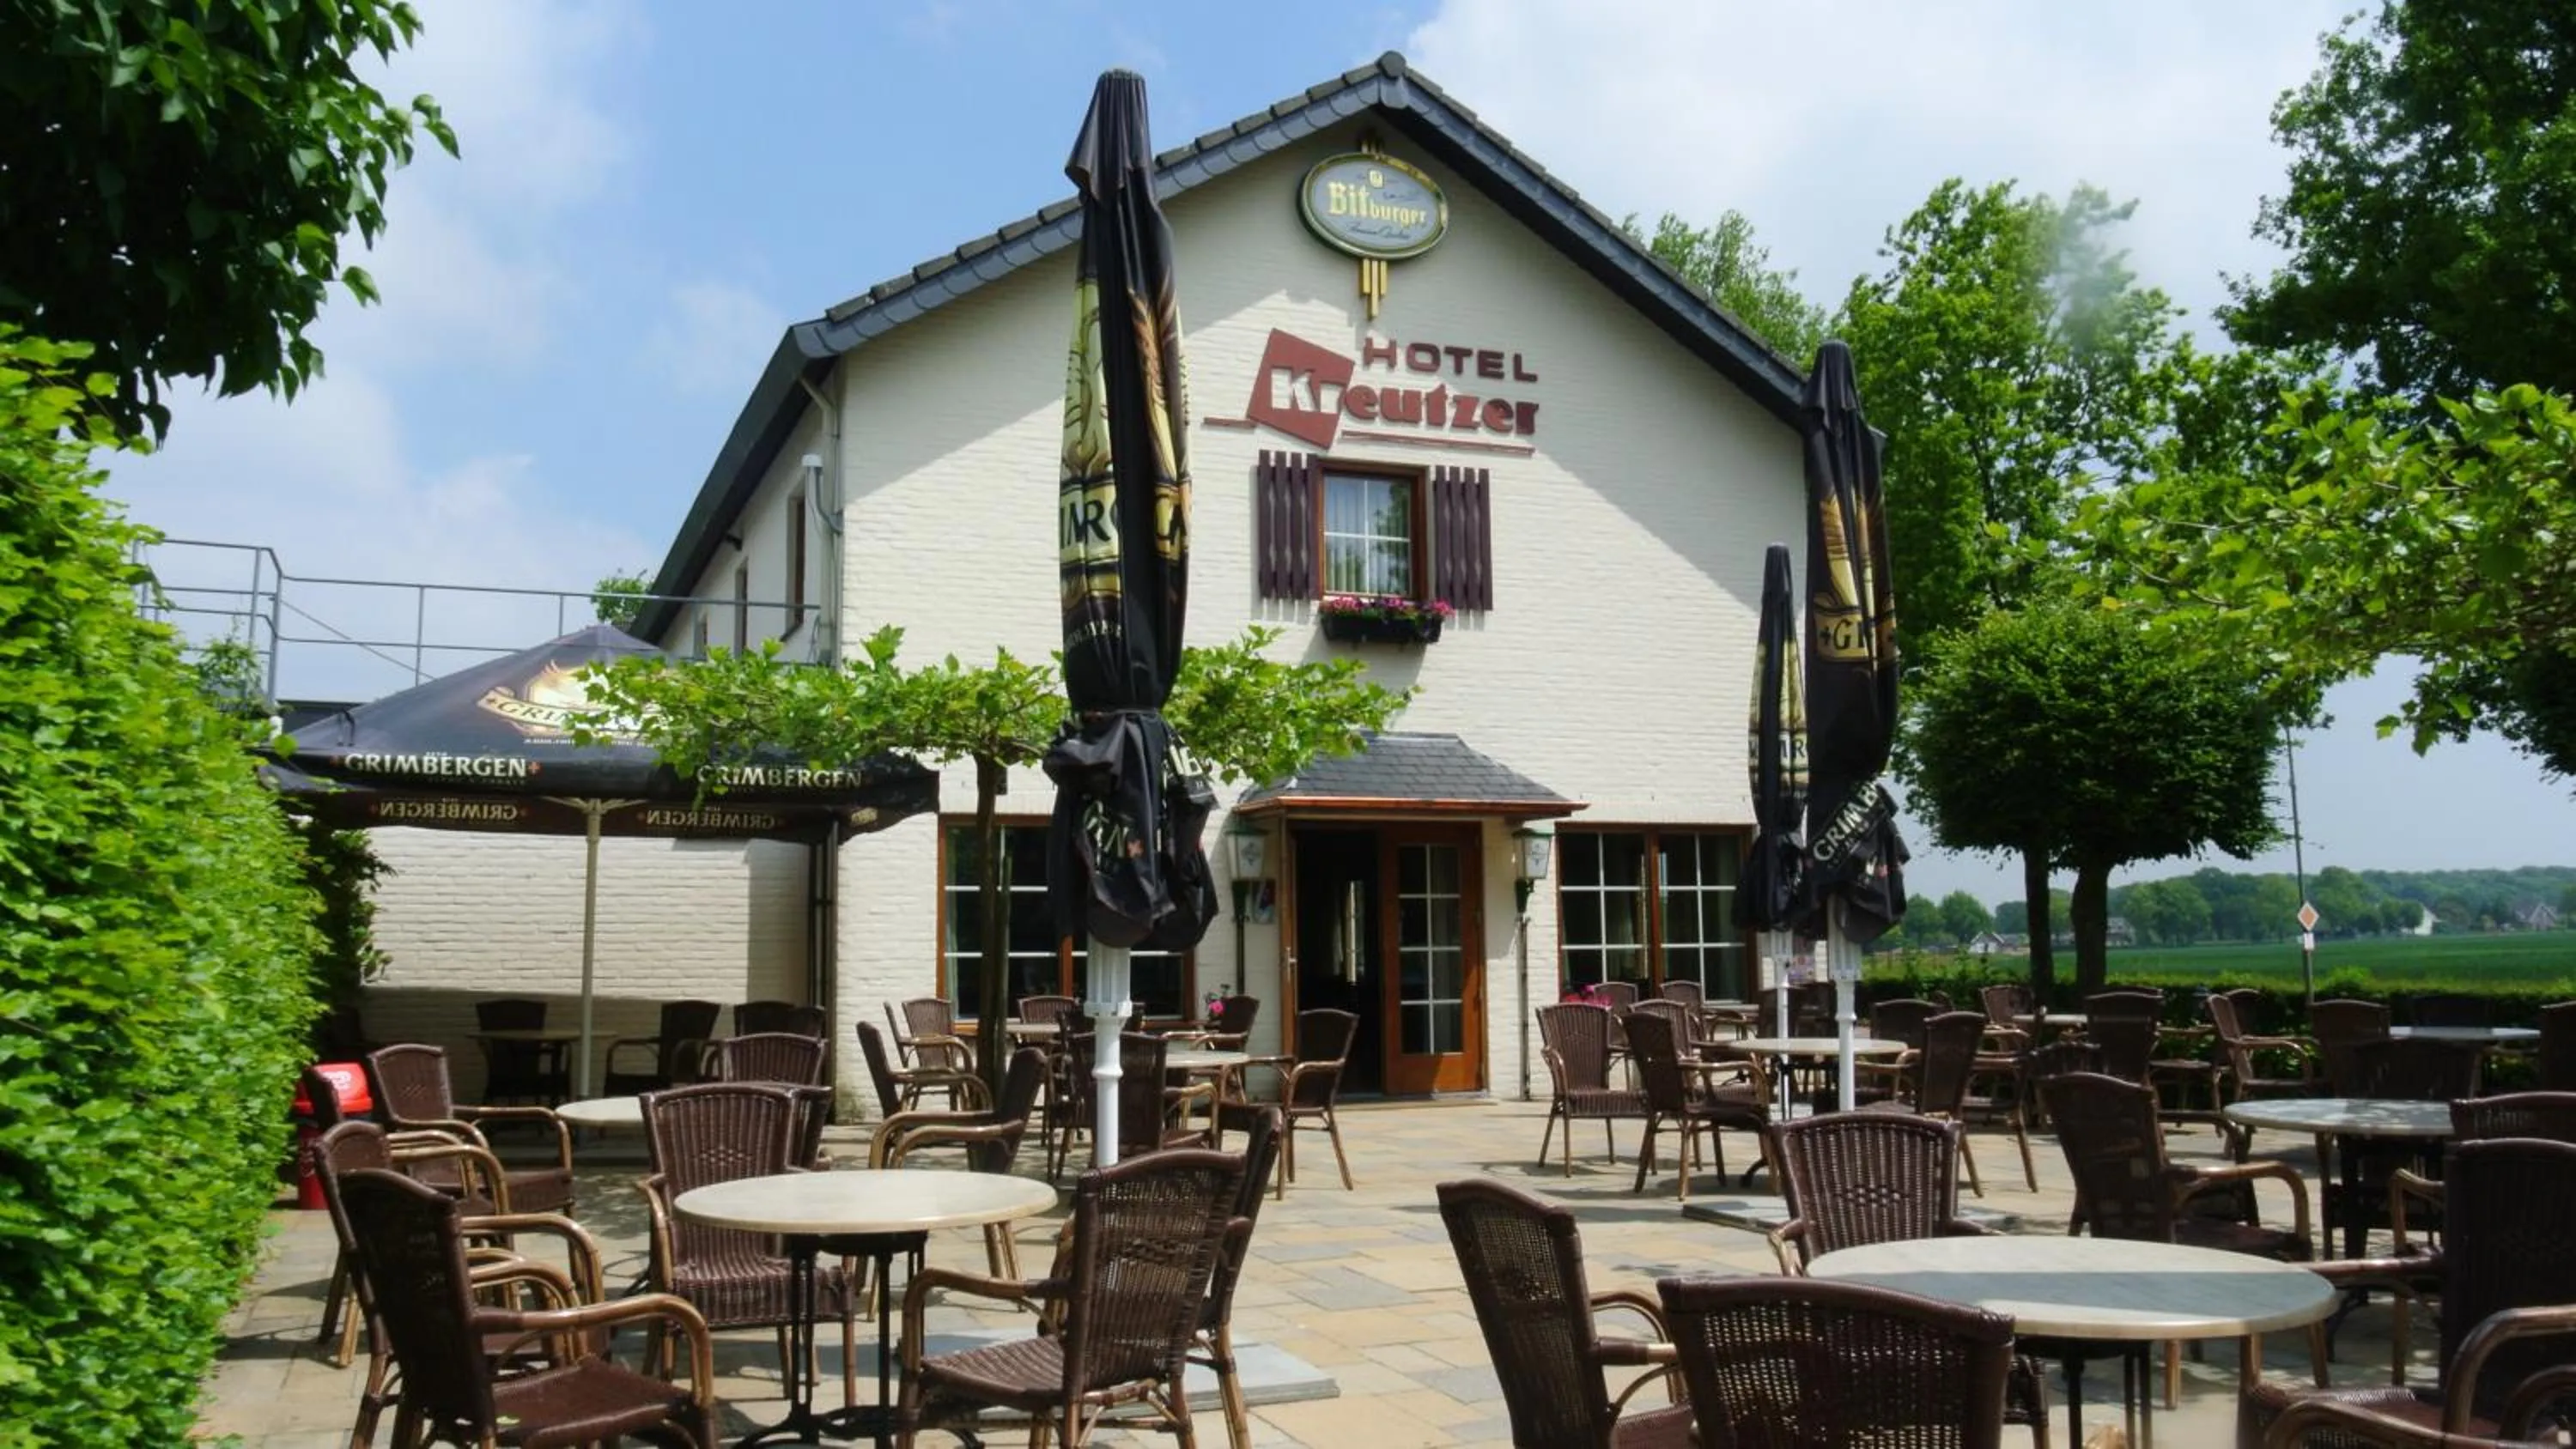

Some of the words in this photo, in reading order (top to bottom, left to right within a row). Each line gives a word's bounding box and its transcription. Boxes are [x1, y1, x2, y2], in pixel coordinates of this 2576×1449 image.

[1327, 181, 1427, 229] Bitburger
[1363, 338, 1539, 383] HOTEL
[1270, 367, 1540, 435] Kreutzer
[345, 753, 527, 777] GRIMBERGEN
[1813, 774, 1879, 862] GRIMB
